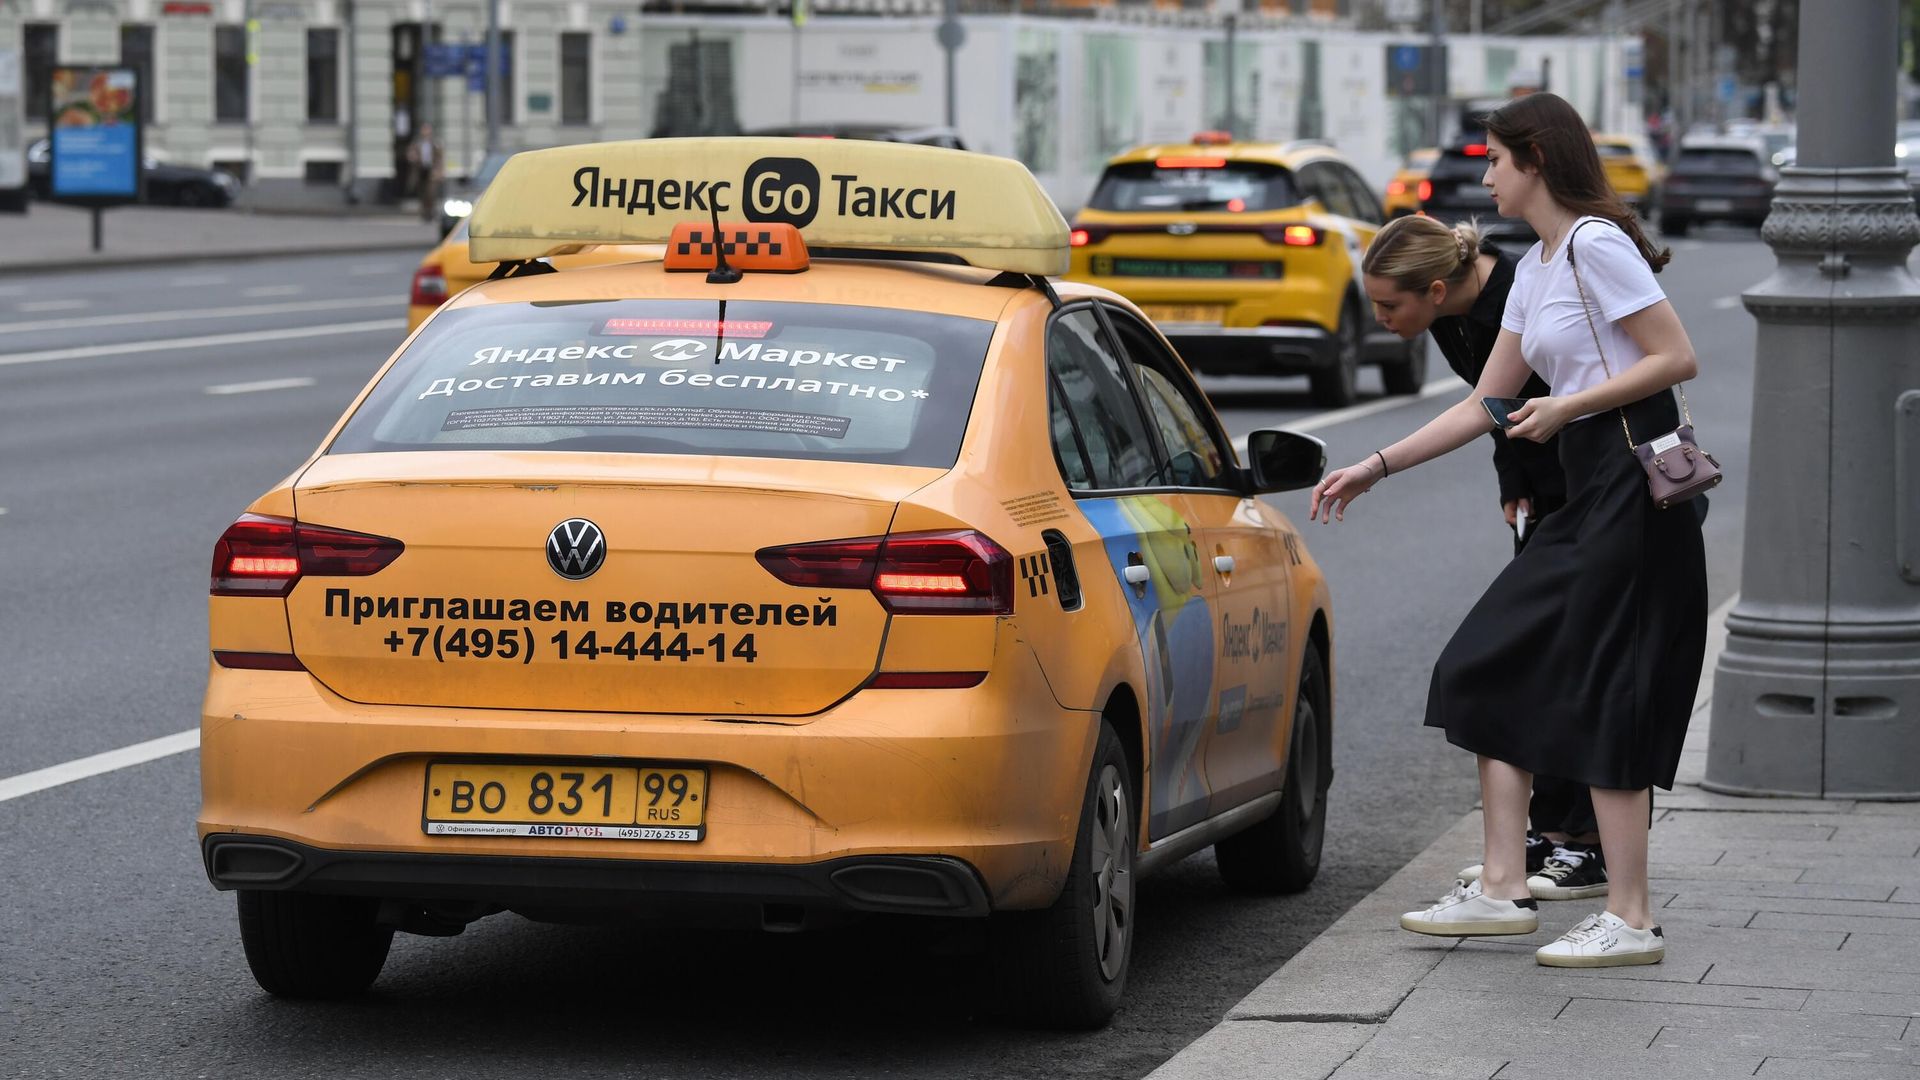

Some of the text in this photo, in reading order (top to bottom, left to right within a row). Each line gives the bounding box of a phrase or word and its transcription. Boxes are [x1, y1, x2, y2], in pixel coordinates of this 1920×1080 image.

[571, 166, 956, 220] Яндекс Go Такси
[468, 342, 906, 373] Яндекс Маркет
[418, 372, 646, 400] Доставим
[324, 588, 838, 629] Приглашаем водителей
[383, 625, 757, 664] +7(495) 14-444-14
[451, 772, 688, 817] ВО 831 99
[648, 808, 680, 820] RUS
[447, 825, 495, 834] Официальный
[496, 827, 517, 835] дилер
[528, 825, 603, 837] АВТОРУСЬ
[618, 828, 642, 838] (495)
[644, 829, 661, 839] 276
[664, 830, 676, 839] 25
[678, 831, 690, 840] 25
